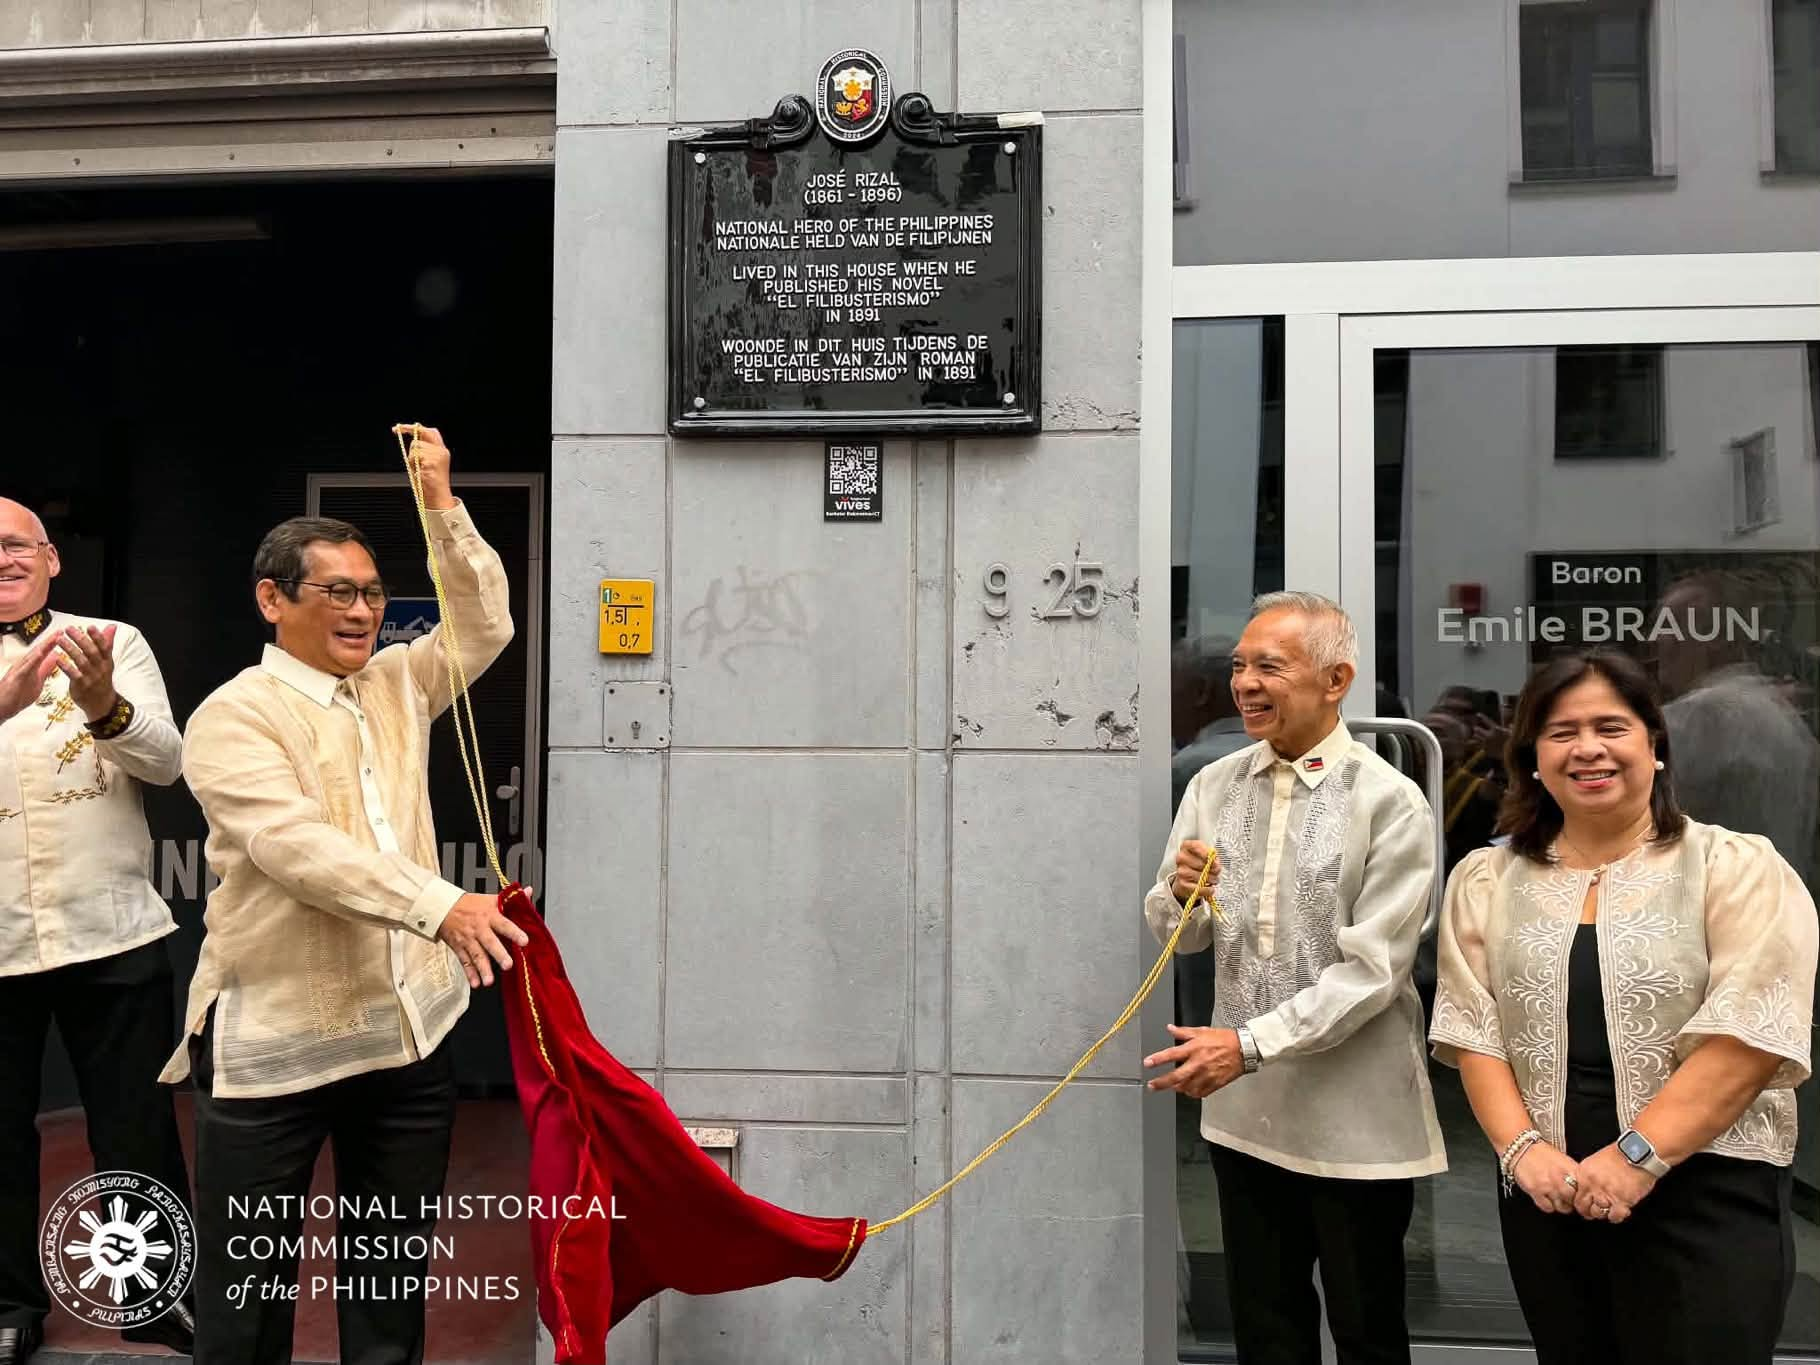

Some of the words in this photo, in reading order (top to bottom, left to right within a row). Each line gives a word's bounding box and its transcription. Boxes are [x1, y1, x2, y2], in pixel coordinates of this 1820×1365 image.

[807, 170, 846, 188] JOSÉ
[856, 173, 899, 187] RIZAL
[804, 189, 842, 204] (1861
[861, 188, 902, 202] 1896)
[716, 221, 788, 236] NATIONAL
[794, 220, 832, 234] HERO
[839, 219, 858, 232] OF
[865, 218, 894, 232] THE
[901, 215, 993, 231] PHILIPPINES
[718, 236, 799, 250] NATIONALE
[806, 235, 845, 248] HELD
[851, 234, 879, 247] VAN
[886, 233, 903, 246] DE
[909, 231, 992, 246] FILIPIJNEN
[733, 265, 776, 279] LIVED
[784, 264, 797, 278] IN
[806, 264, 839, 278] THIS
[848, 263, 896, 277] HOUSE
[904, 262, 947, 276] WHEN
[955, 261, 976, 274] HE
[764, 279, 849, 293] PUBLISHED
[858, 279, 881, 292] HIS
[892, 277, 943, 291] NOVEL
[826, 309, 840, 322] IN
[849, 309, 881, 322] 1891
[722, 339, 784, 353] WOONDE
[794, 339, 808, 352] IN
[819, 339, 841, 352] DIT
[852, 338, 885, 351] HUIS
[894, 337, 957, 351] TIJDENS
[968, 336, 988, 349] DE
[734, 354, 819, 368] PUBLICATIE
[832, 353, 861, 366] VAN
[874, 353, 907, 366] ZIJN
[921, 352, 975, 364] ROMAN
[918, 367, 932, 380] IN
[944, 366, 976, 379] 1891
[835, 501, 870, 510] vives
[1551, 561, 1642, 584] Baron
[983, 562, 1010, 618] 9
[1042, 561, 1104, 618] 25
[1438, 607, 1565, 643] Emile
[1582, 607, 1760, 643] BRAUN
